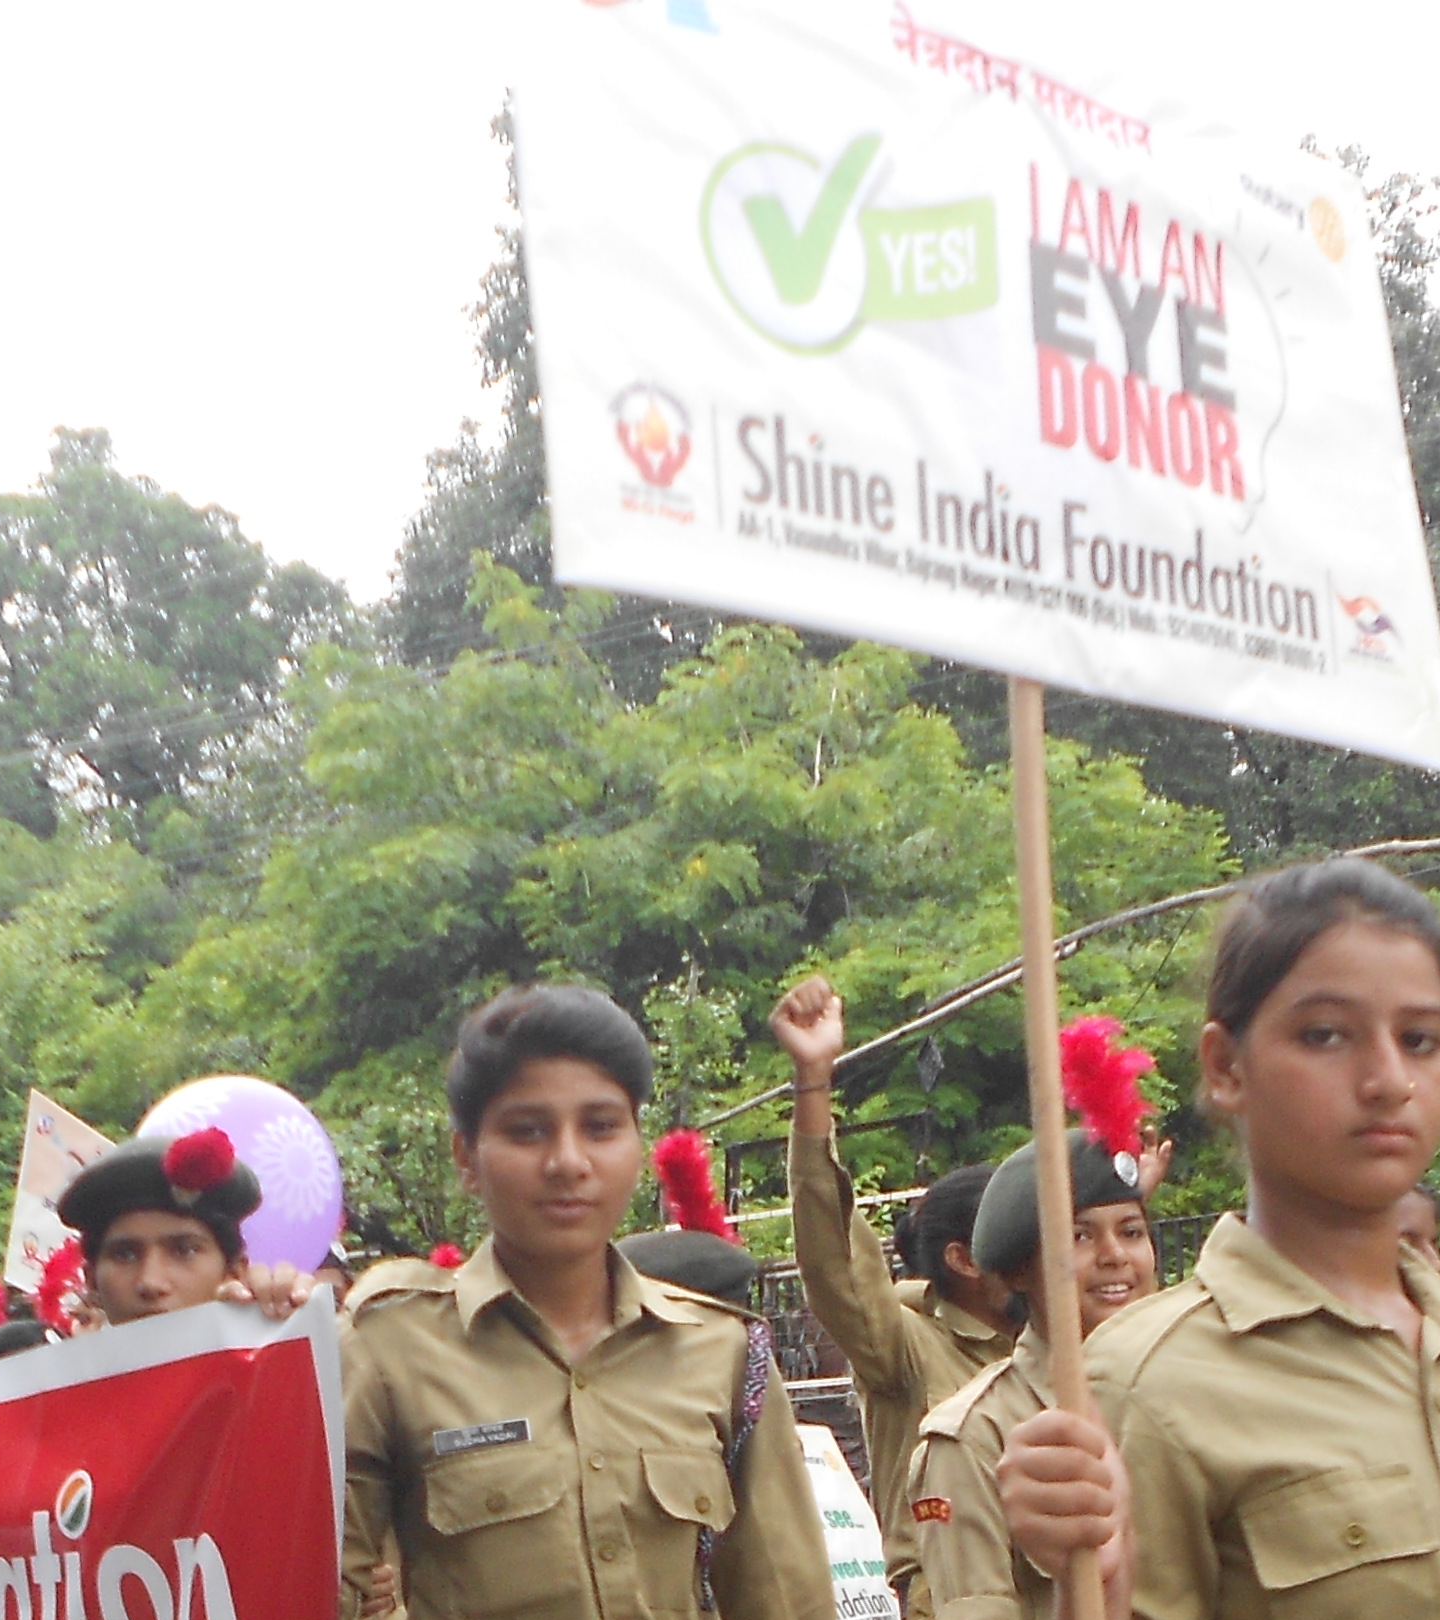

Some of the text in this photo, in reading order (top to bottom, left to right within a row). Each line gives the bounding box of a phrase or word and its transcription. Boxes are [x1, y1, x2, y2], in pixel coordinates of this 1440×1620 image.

[1030, 70, 1153, 159] महादान
[879, 214, 977, 298] YES!
[1027, 160, 1040, 246] I
[1058, 176, 1142, 280] AM
[1160, 217, 1227, 317] AN
[1029, 241, 1237, 412] EYE
[1036, 342, 1246, 503] DONOR
[737, 413, 895, 533] Shine
[916, 457, 1041, 572] India
[1062, 501, 1319, 641] Foundation
[831, 1558, 864, 1580] ved
